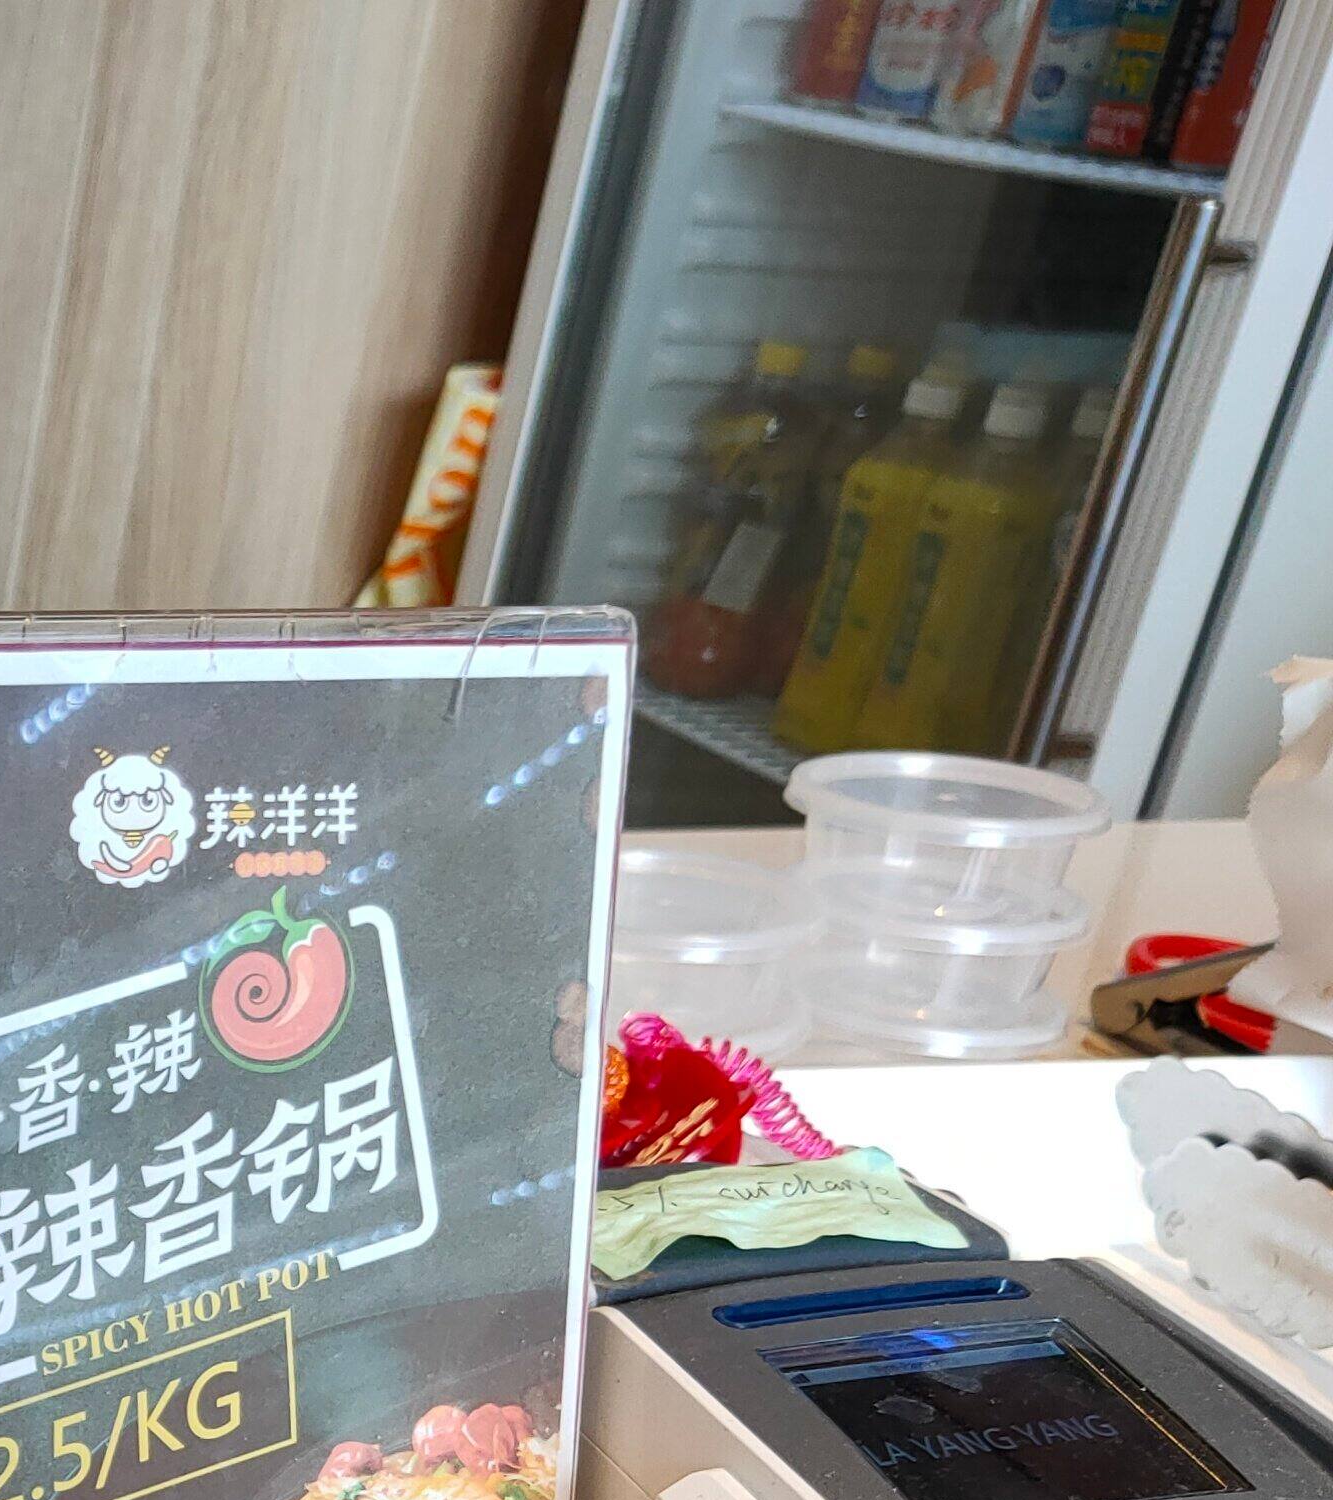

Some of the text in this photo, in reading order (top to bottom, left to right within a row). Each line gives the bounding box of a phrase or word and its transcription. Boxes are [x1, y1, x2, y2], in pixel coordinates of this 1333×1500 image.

[199, 782, 358, 849] 辣洋洋
[42, 1249, 334, 1376] SPICY HOT POT
[862, 1415, 1119, 1468] LA YANG YANG
